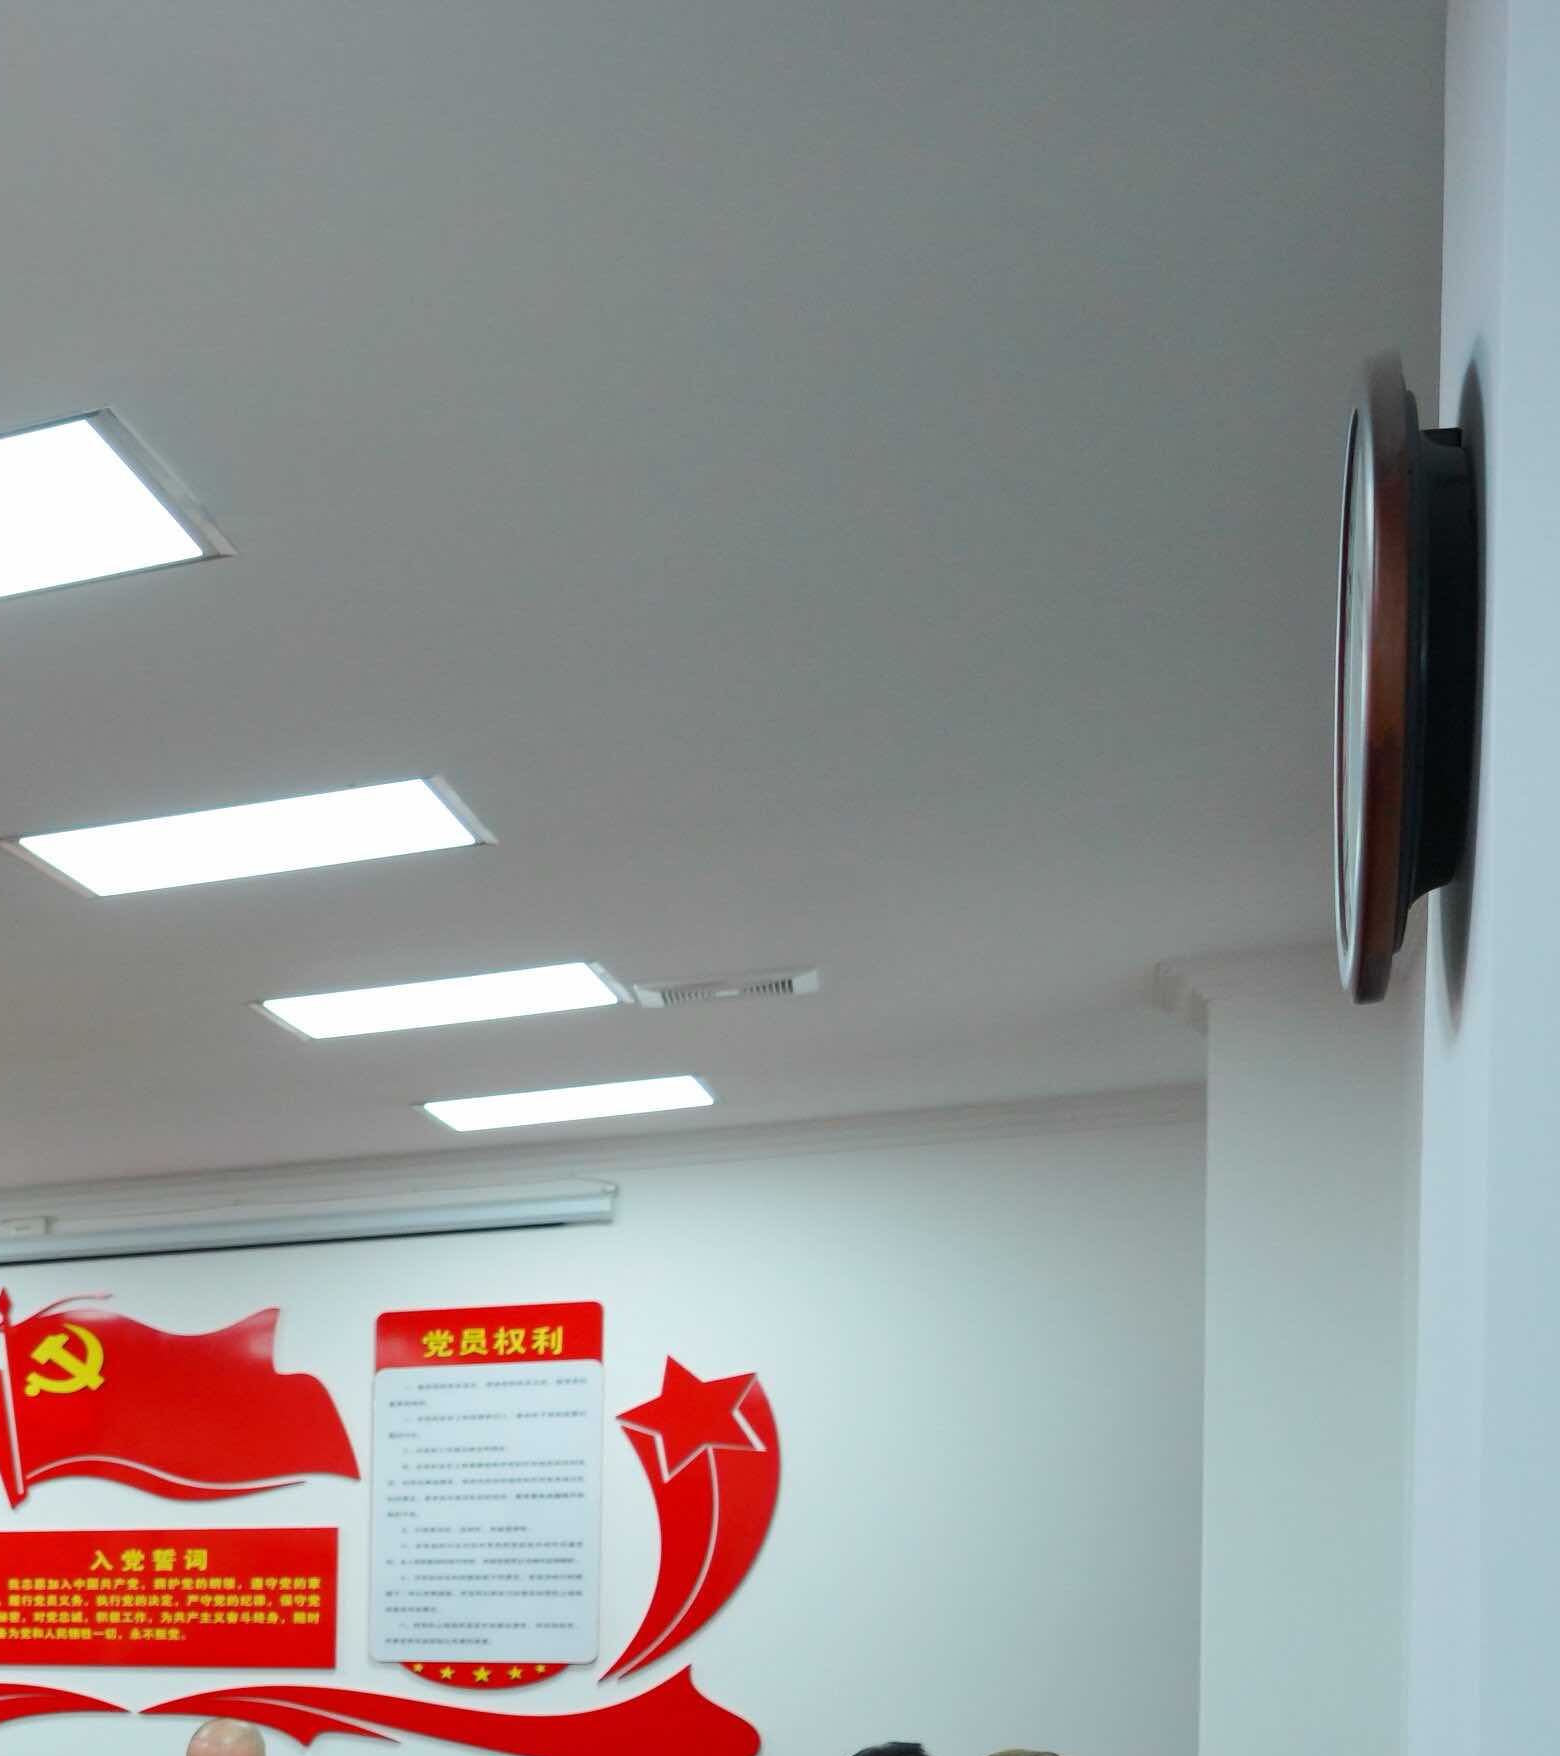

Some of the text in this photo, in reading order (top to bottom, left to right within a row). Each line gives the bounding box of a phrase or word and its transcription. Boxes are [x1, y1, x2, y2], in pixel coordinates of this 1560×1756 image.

[422, 1325, 564, 1358] 党员权利
[89, 1548, 209, 1572] 入党誓词
